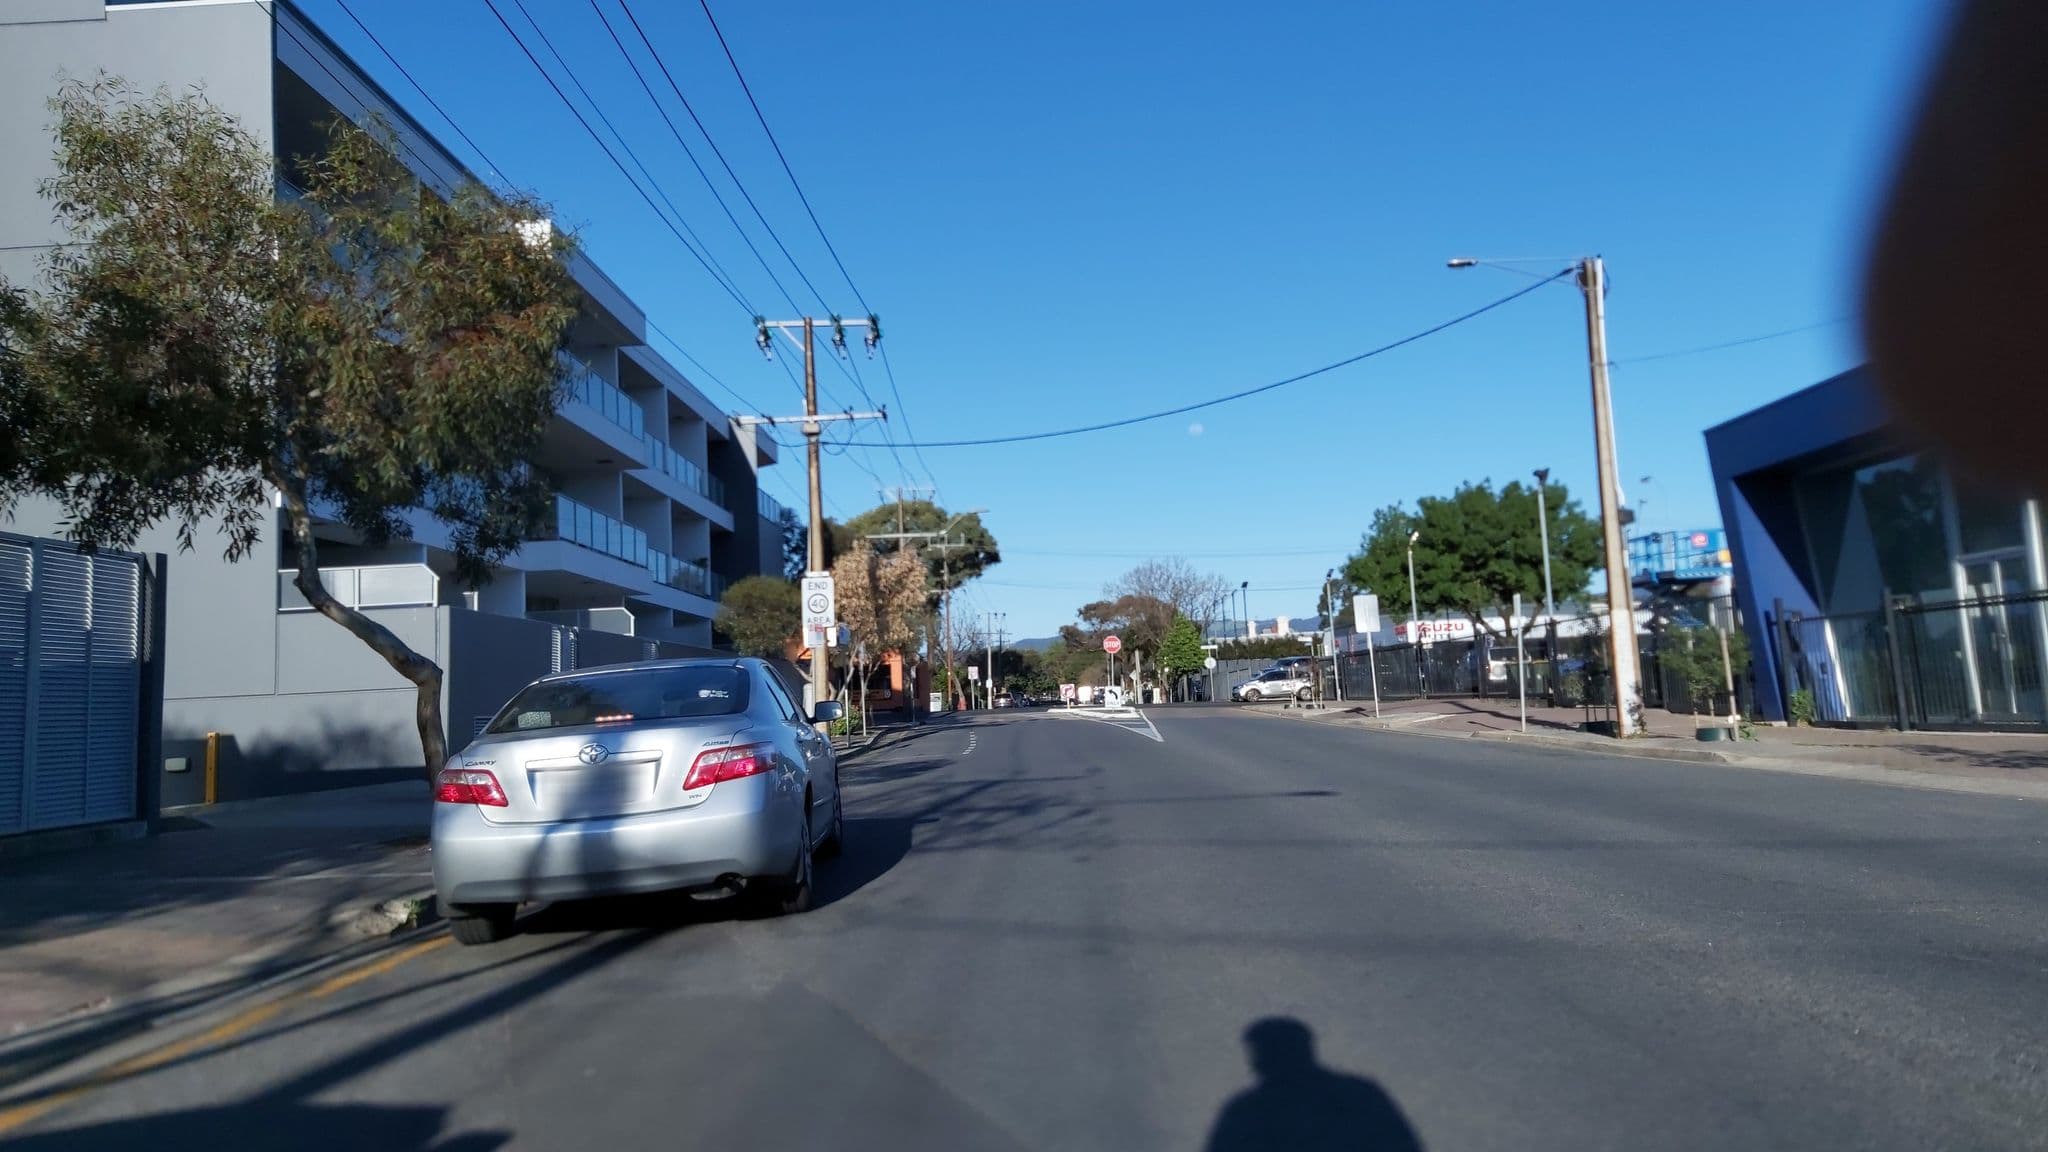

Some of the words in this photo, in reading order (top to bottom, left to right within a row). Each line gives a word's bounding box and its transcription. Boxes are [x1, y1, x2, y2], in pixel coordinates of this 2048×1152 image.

[809, 582, 828, 592] END
[810, 598, 827, 610] 40
[808, 616, 832, 626] AREA
[1104, 640, 1120, 648] STOP
